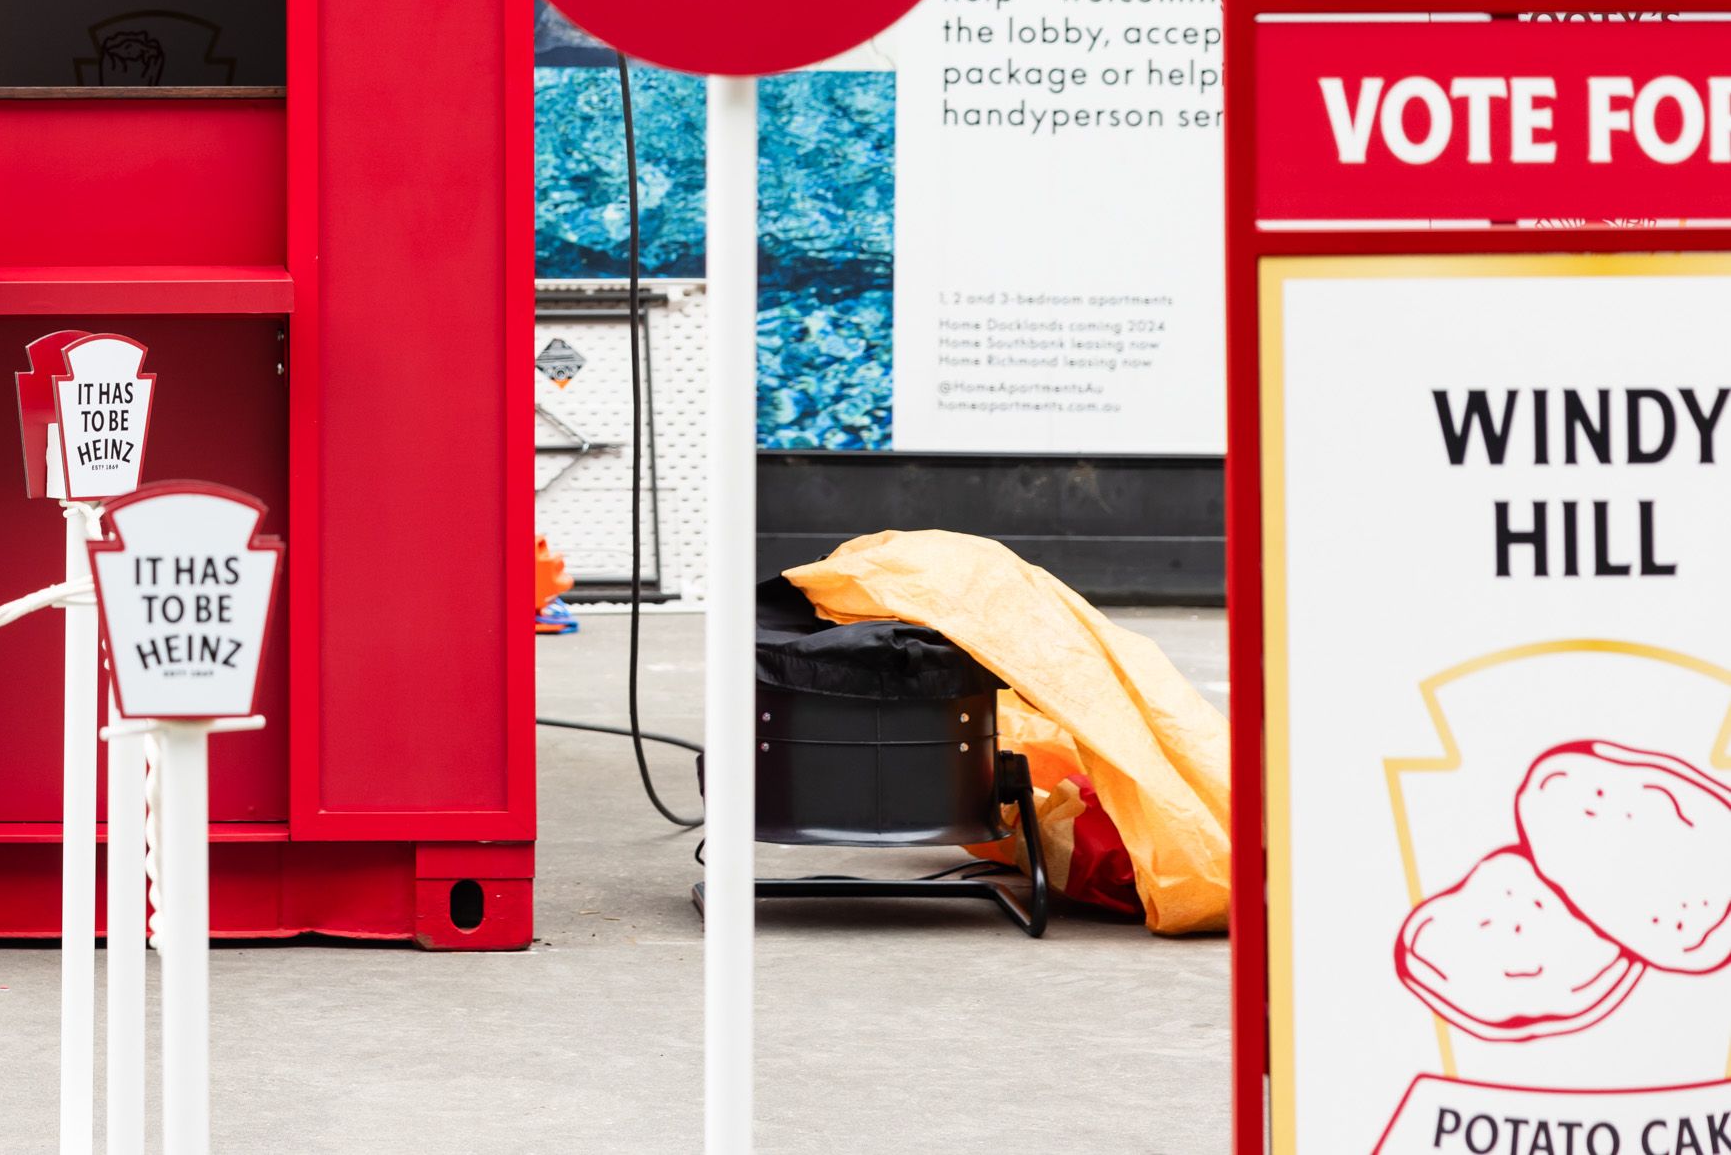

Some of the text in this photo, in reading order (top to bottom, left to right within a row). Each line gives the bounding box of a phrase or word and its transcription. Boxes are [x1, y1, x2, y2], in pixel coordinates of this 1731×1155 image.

[943, 17, 1221, 52] the lobby, accep
[943, 59, 1088, 93] package
[1101, 69, 1135, 86] or
[943, 100, 1163, 135] handyperson
[1318, 76, 1557, 164] VOTE
[77, 381, 134, 405] IT HAS
[81, 409, 130, 433] TO BE
[1432, 387, 1731, 465] WINDY
[77, 438, 134, 466] HEINZ
[1494, 500, 1678, 577] HILL
[134, 557, 240, 585] IT HAS
[141, 595, 233, 624] TO BE
[135, 633, 242, 669] HEINZ
[1434, 1107, 1621, 1155] POTATO
